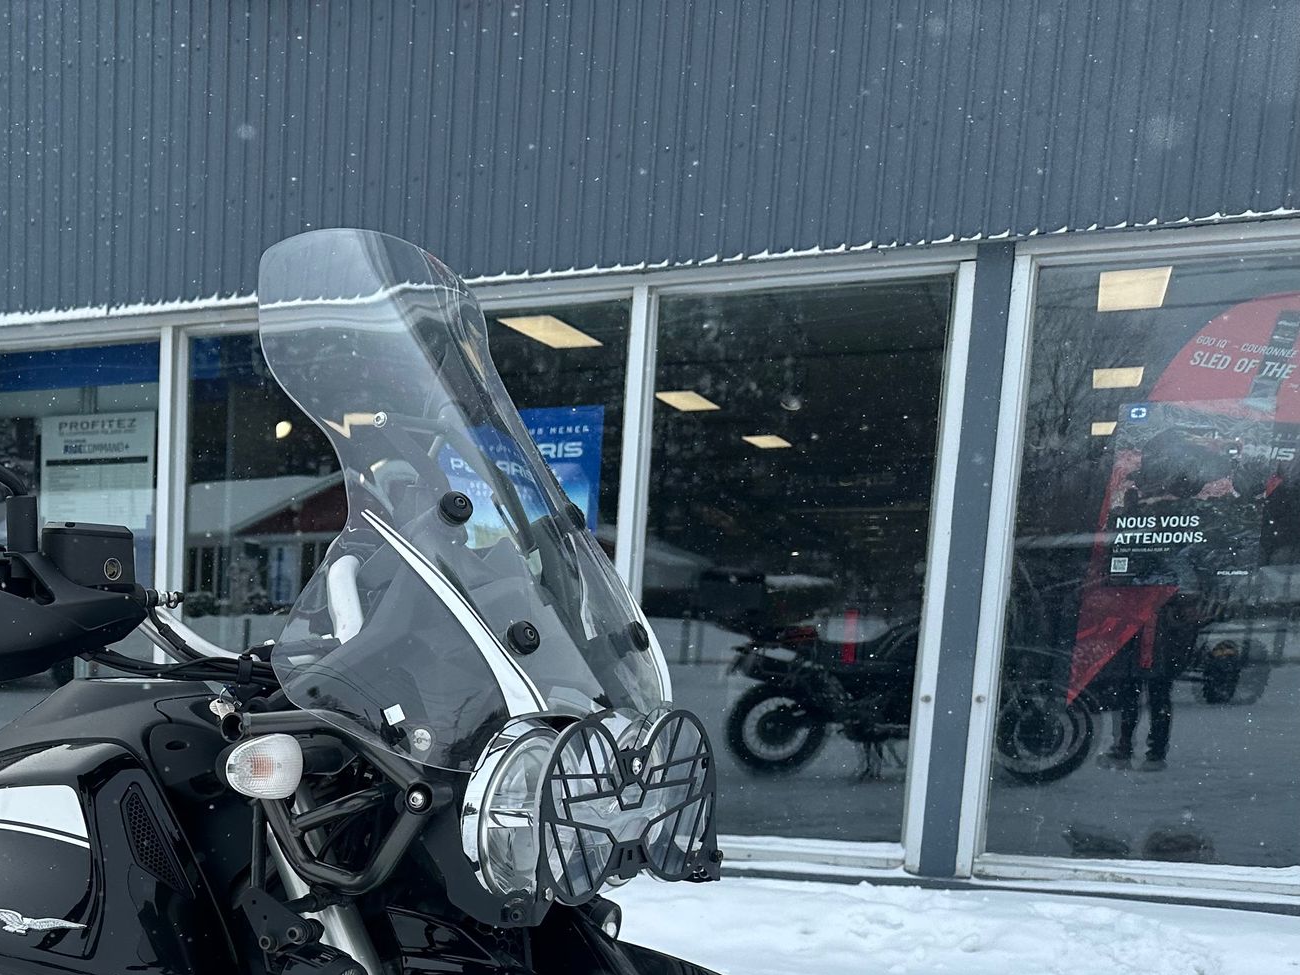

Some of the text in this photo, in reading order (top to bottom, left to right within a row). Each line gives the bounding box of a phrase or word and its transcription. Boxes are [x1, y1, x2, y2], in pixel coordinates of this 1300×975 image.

[1190, 351, 1297, 379] SLED OF THE
[59, 419, 137, 431] PROFITEZ
[1116, 516, 1200, 528] NOUS VOUS
[1114, 532, 1207, 544] ATTENDONS.
